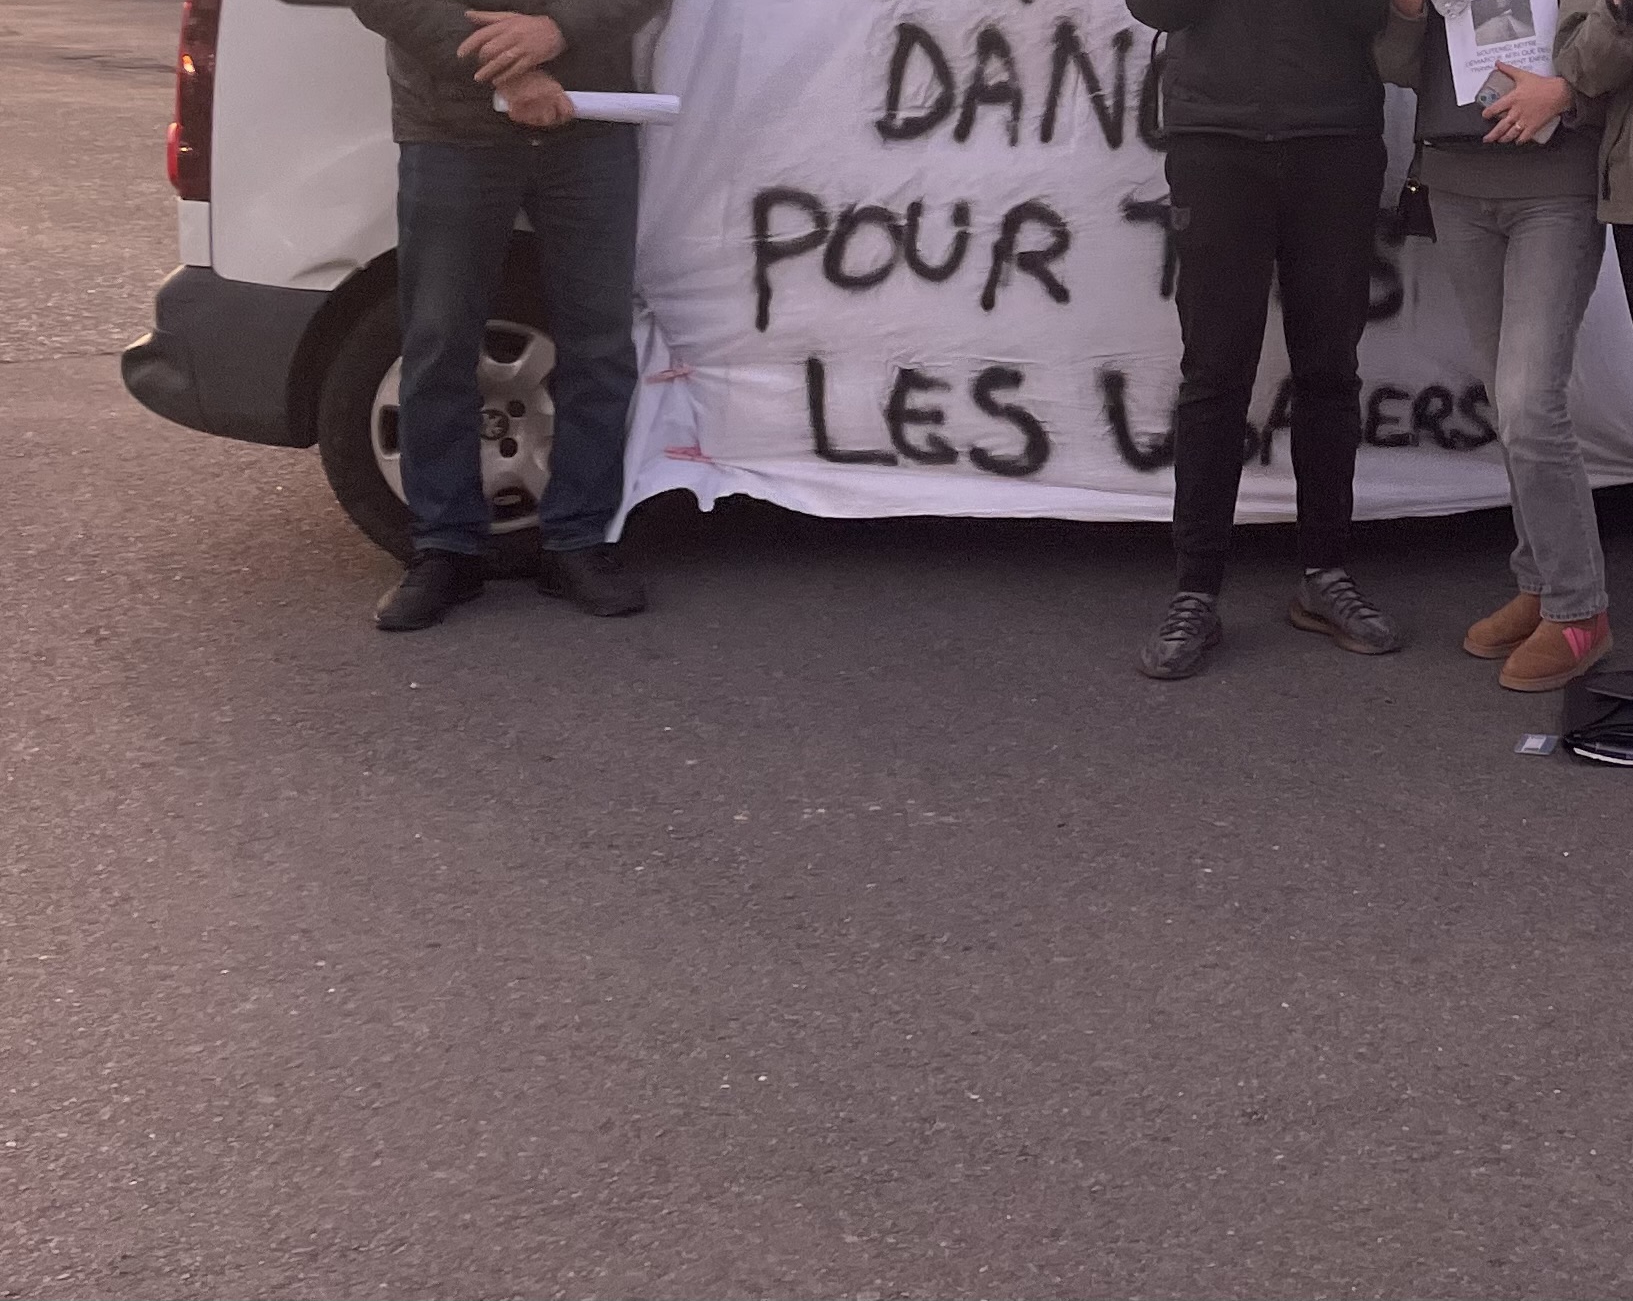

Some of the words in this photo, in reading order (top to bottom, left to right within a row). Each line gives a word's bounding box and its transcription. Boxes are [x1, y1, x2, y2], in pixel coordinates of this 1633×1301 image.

[752, 186, 1071, 331] POUR
[1121, 197, 1404, 323] TS
[806, 356, 1053, 477] LES
